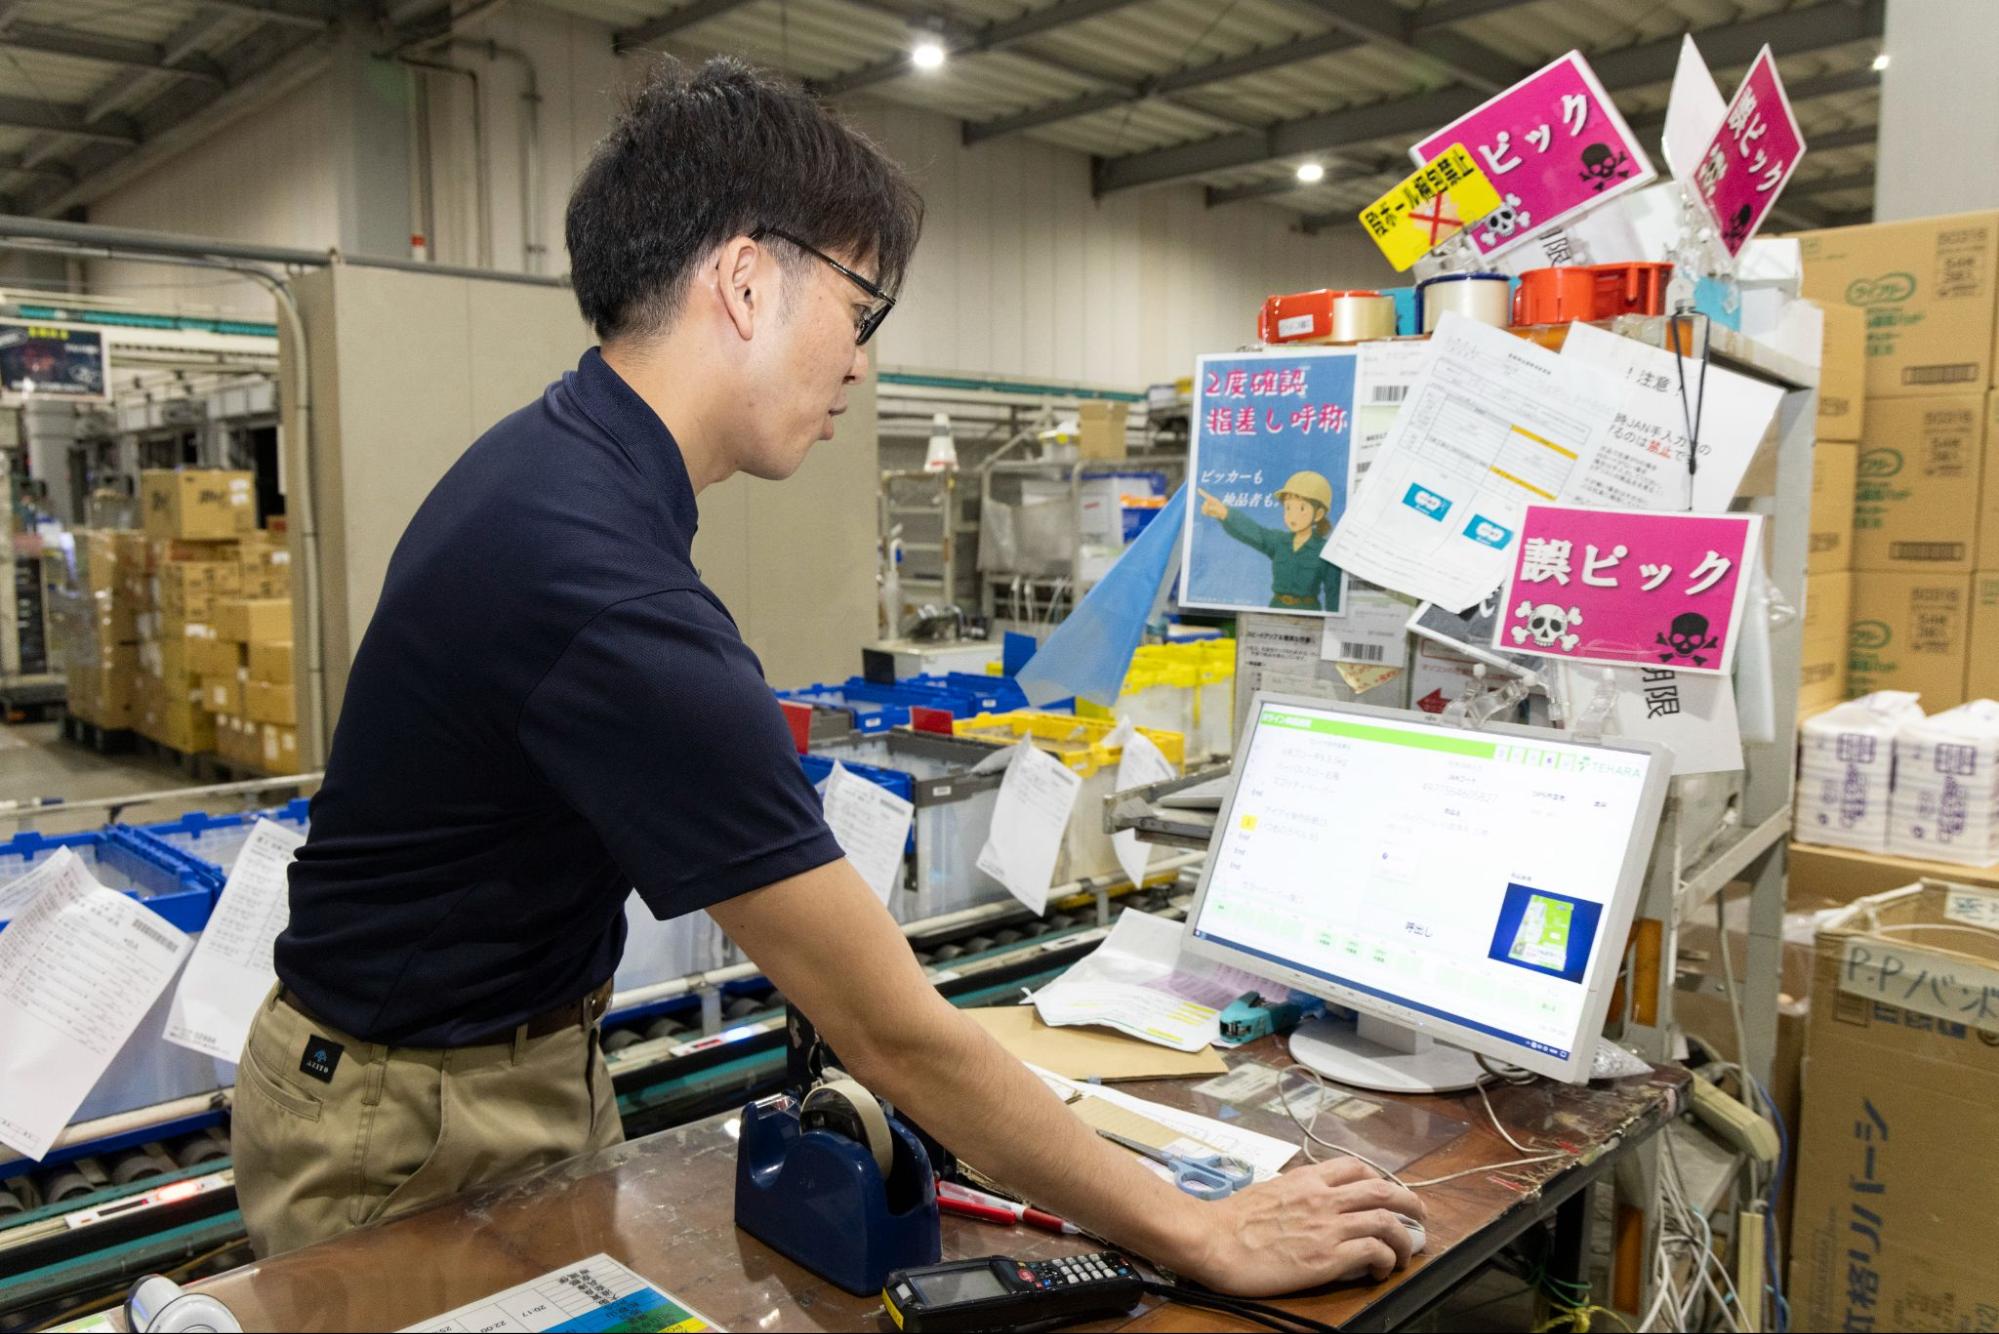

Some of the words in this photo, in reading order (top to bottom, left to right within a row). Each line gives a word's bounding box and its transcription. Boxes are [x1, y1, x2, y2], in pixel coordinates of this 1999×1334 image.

[1538, 228, 1572, 269] 限
[1204, 366, 1308, 398] 2度確認
[1206, 404, 1348, 436] 指差し呼称
[1520, 536, 1732, 597] 誤ピック
